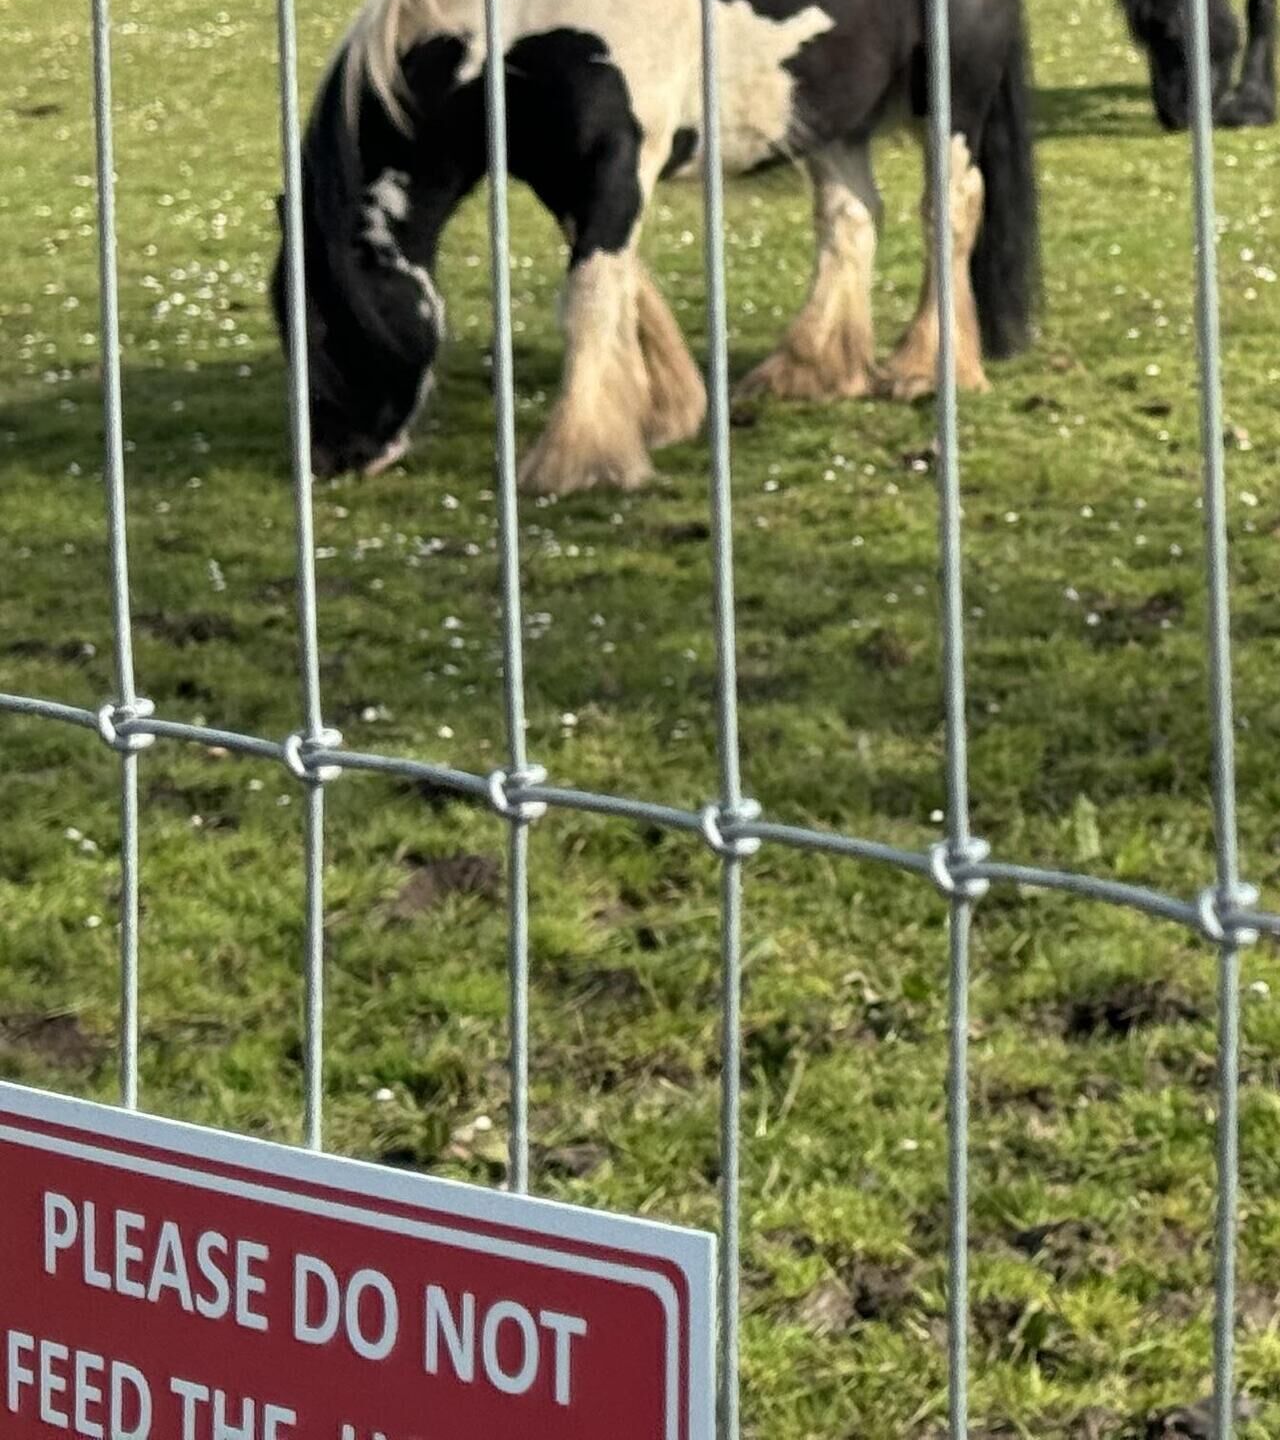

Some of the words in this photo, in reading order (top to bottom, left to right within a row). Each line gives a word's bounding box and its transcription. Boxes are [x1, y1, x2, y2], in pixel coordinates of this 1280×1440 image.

[44, 1190, 270, 1331] PLEASE
[294, 1253, 399, 1361] DO
[425, 1284, 588, 1406] NOT
[7, 1329, 153, 1440] FEED
